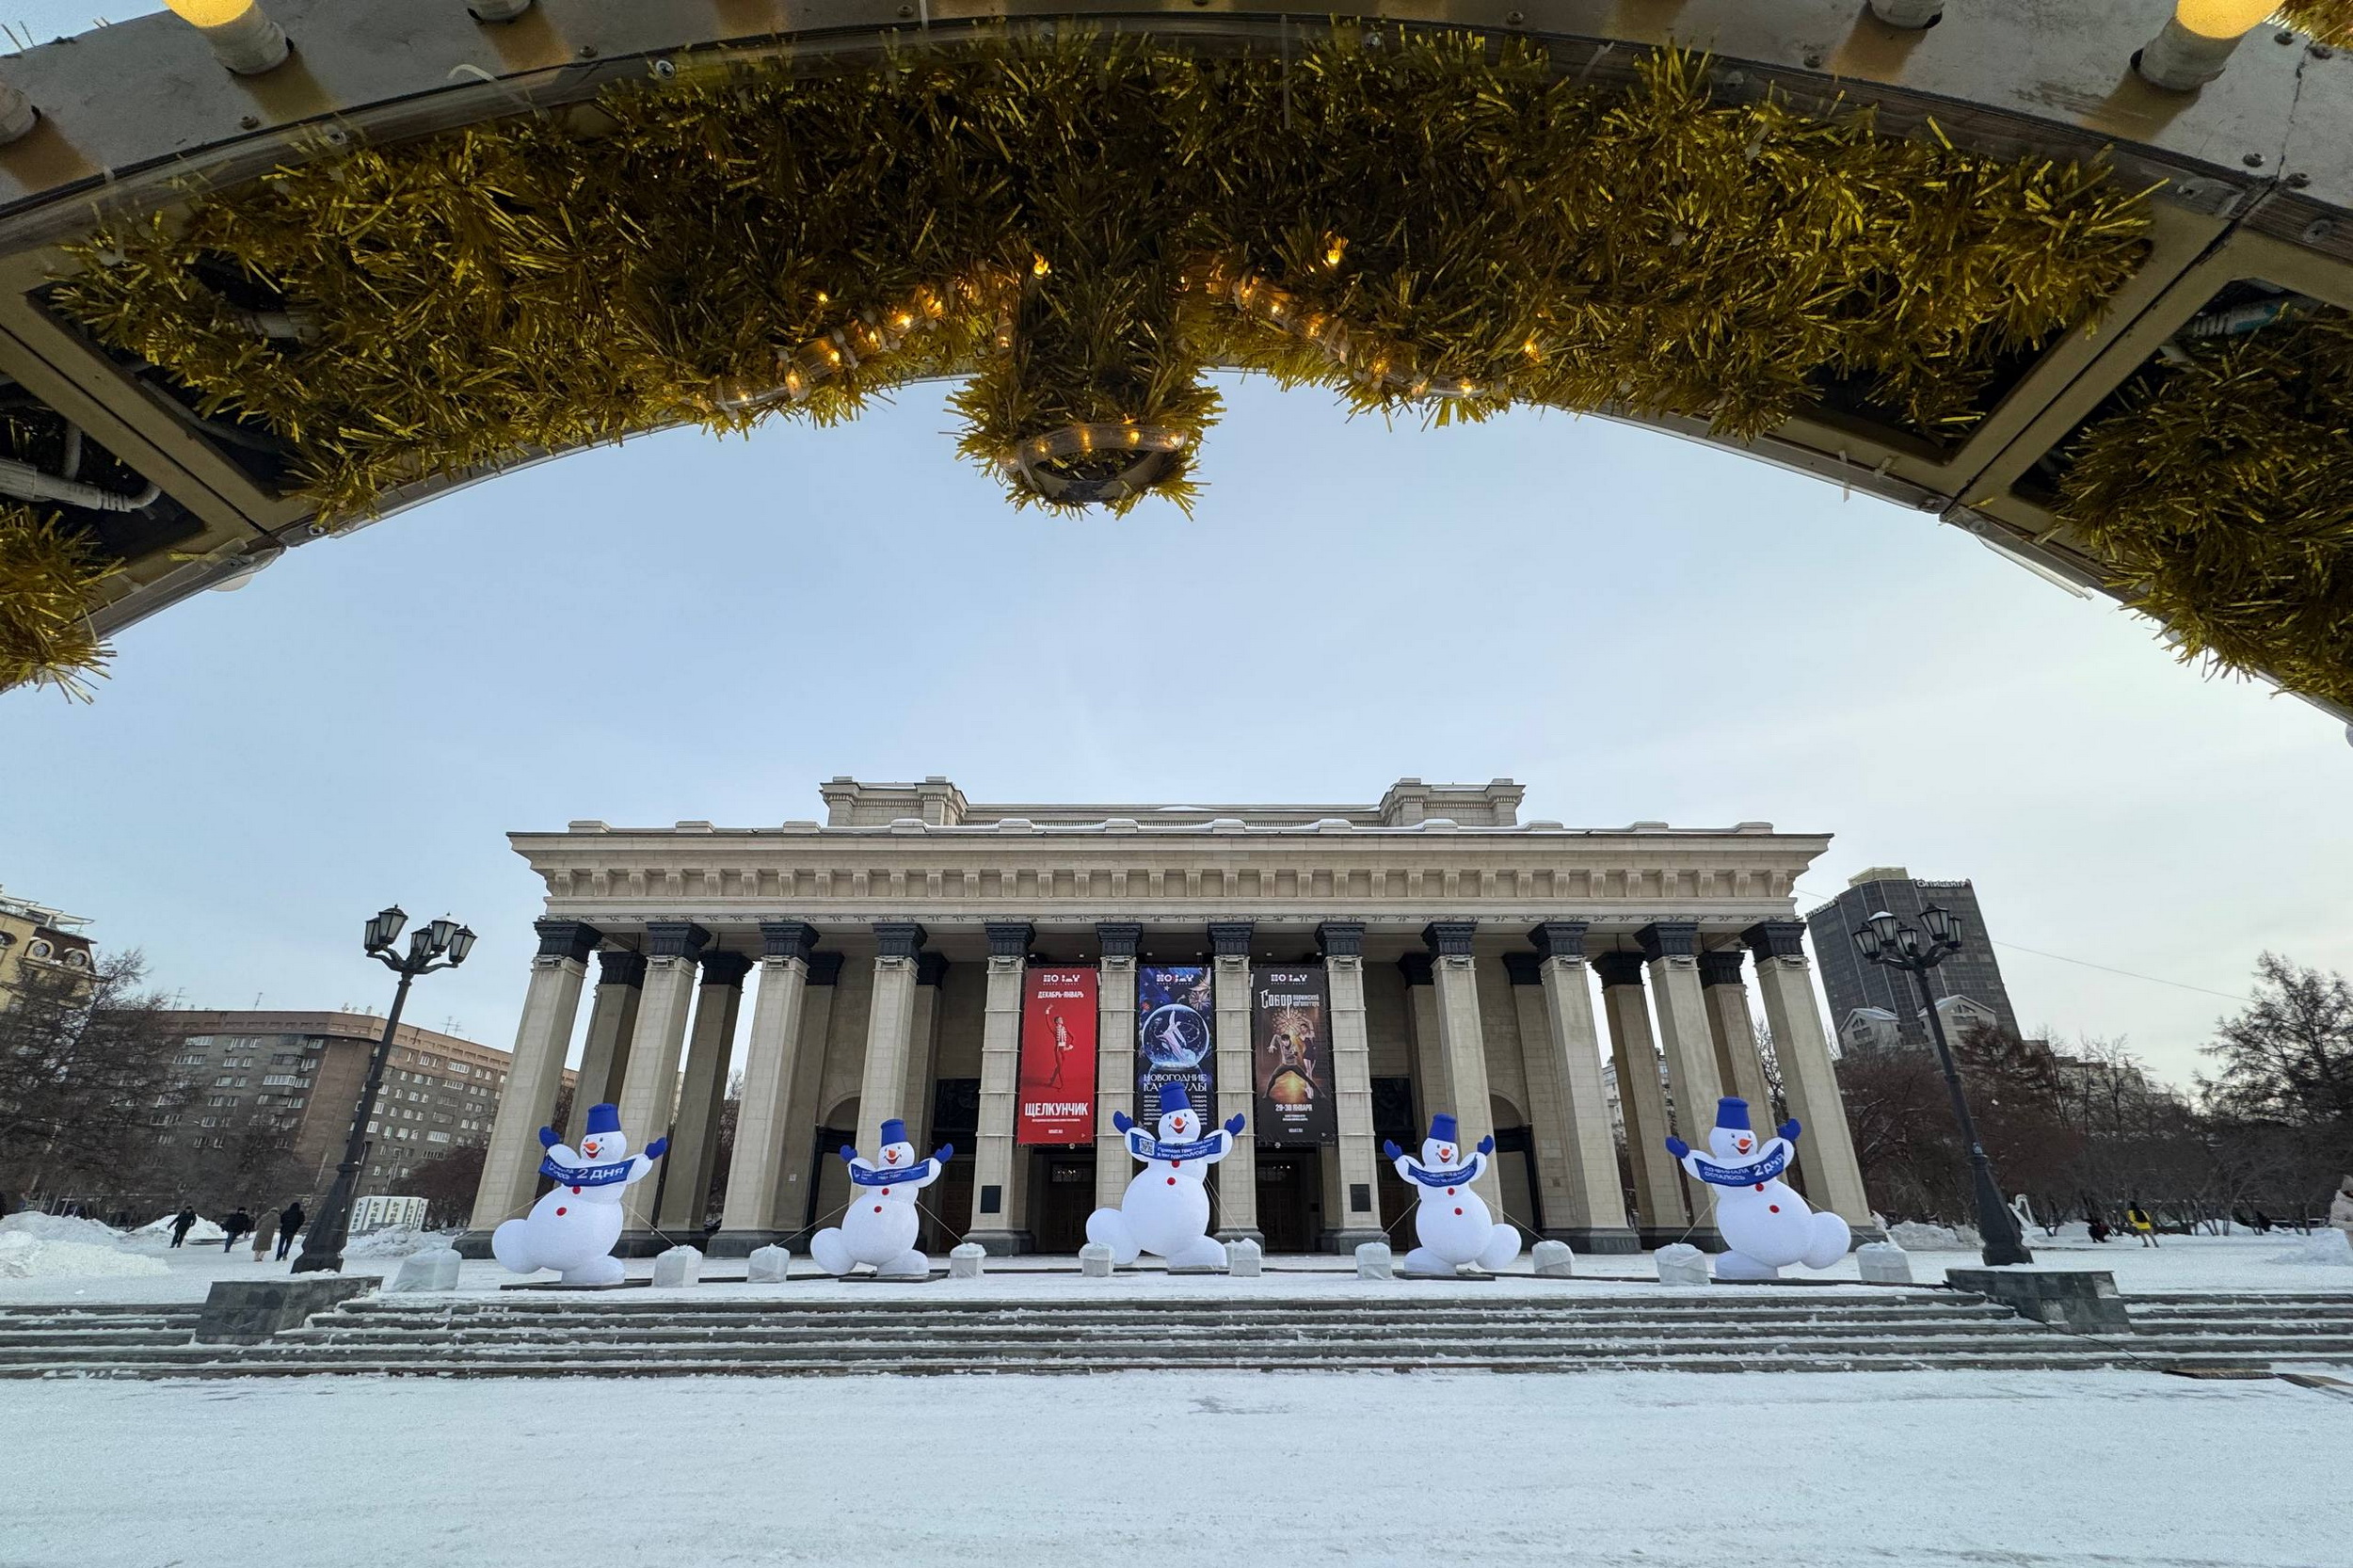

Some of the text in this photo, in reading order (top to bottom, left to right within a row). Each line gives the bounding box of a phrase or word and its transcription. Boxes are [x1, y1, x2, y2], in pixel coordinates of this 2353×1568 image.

[1143, 1074, 1208, 1082] НОВОГОДНИЕ
[1024, 1102, 1089, 1117] ЩЕЛКУНЧИК
[1292, 1103, 1313, 1112] ЯНВАРЯ
[577, 1168, 589, 1179] 2
[590, 1166, 625, 1180] ДНЯ
[1753, 1164, 1763, 1176] 2
